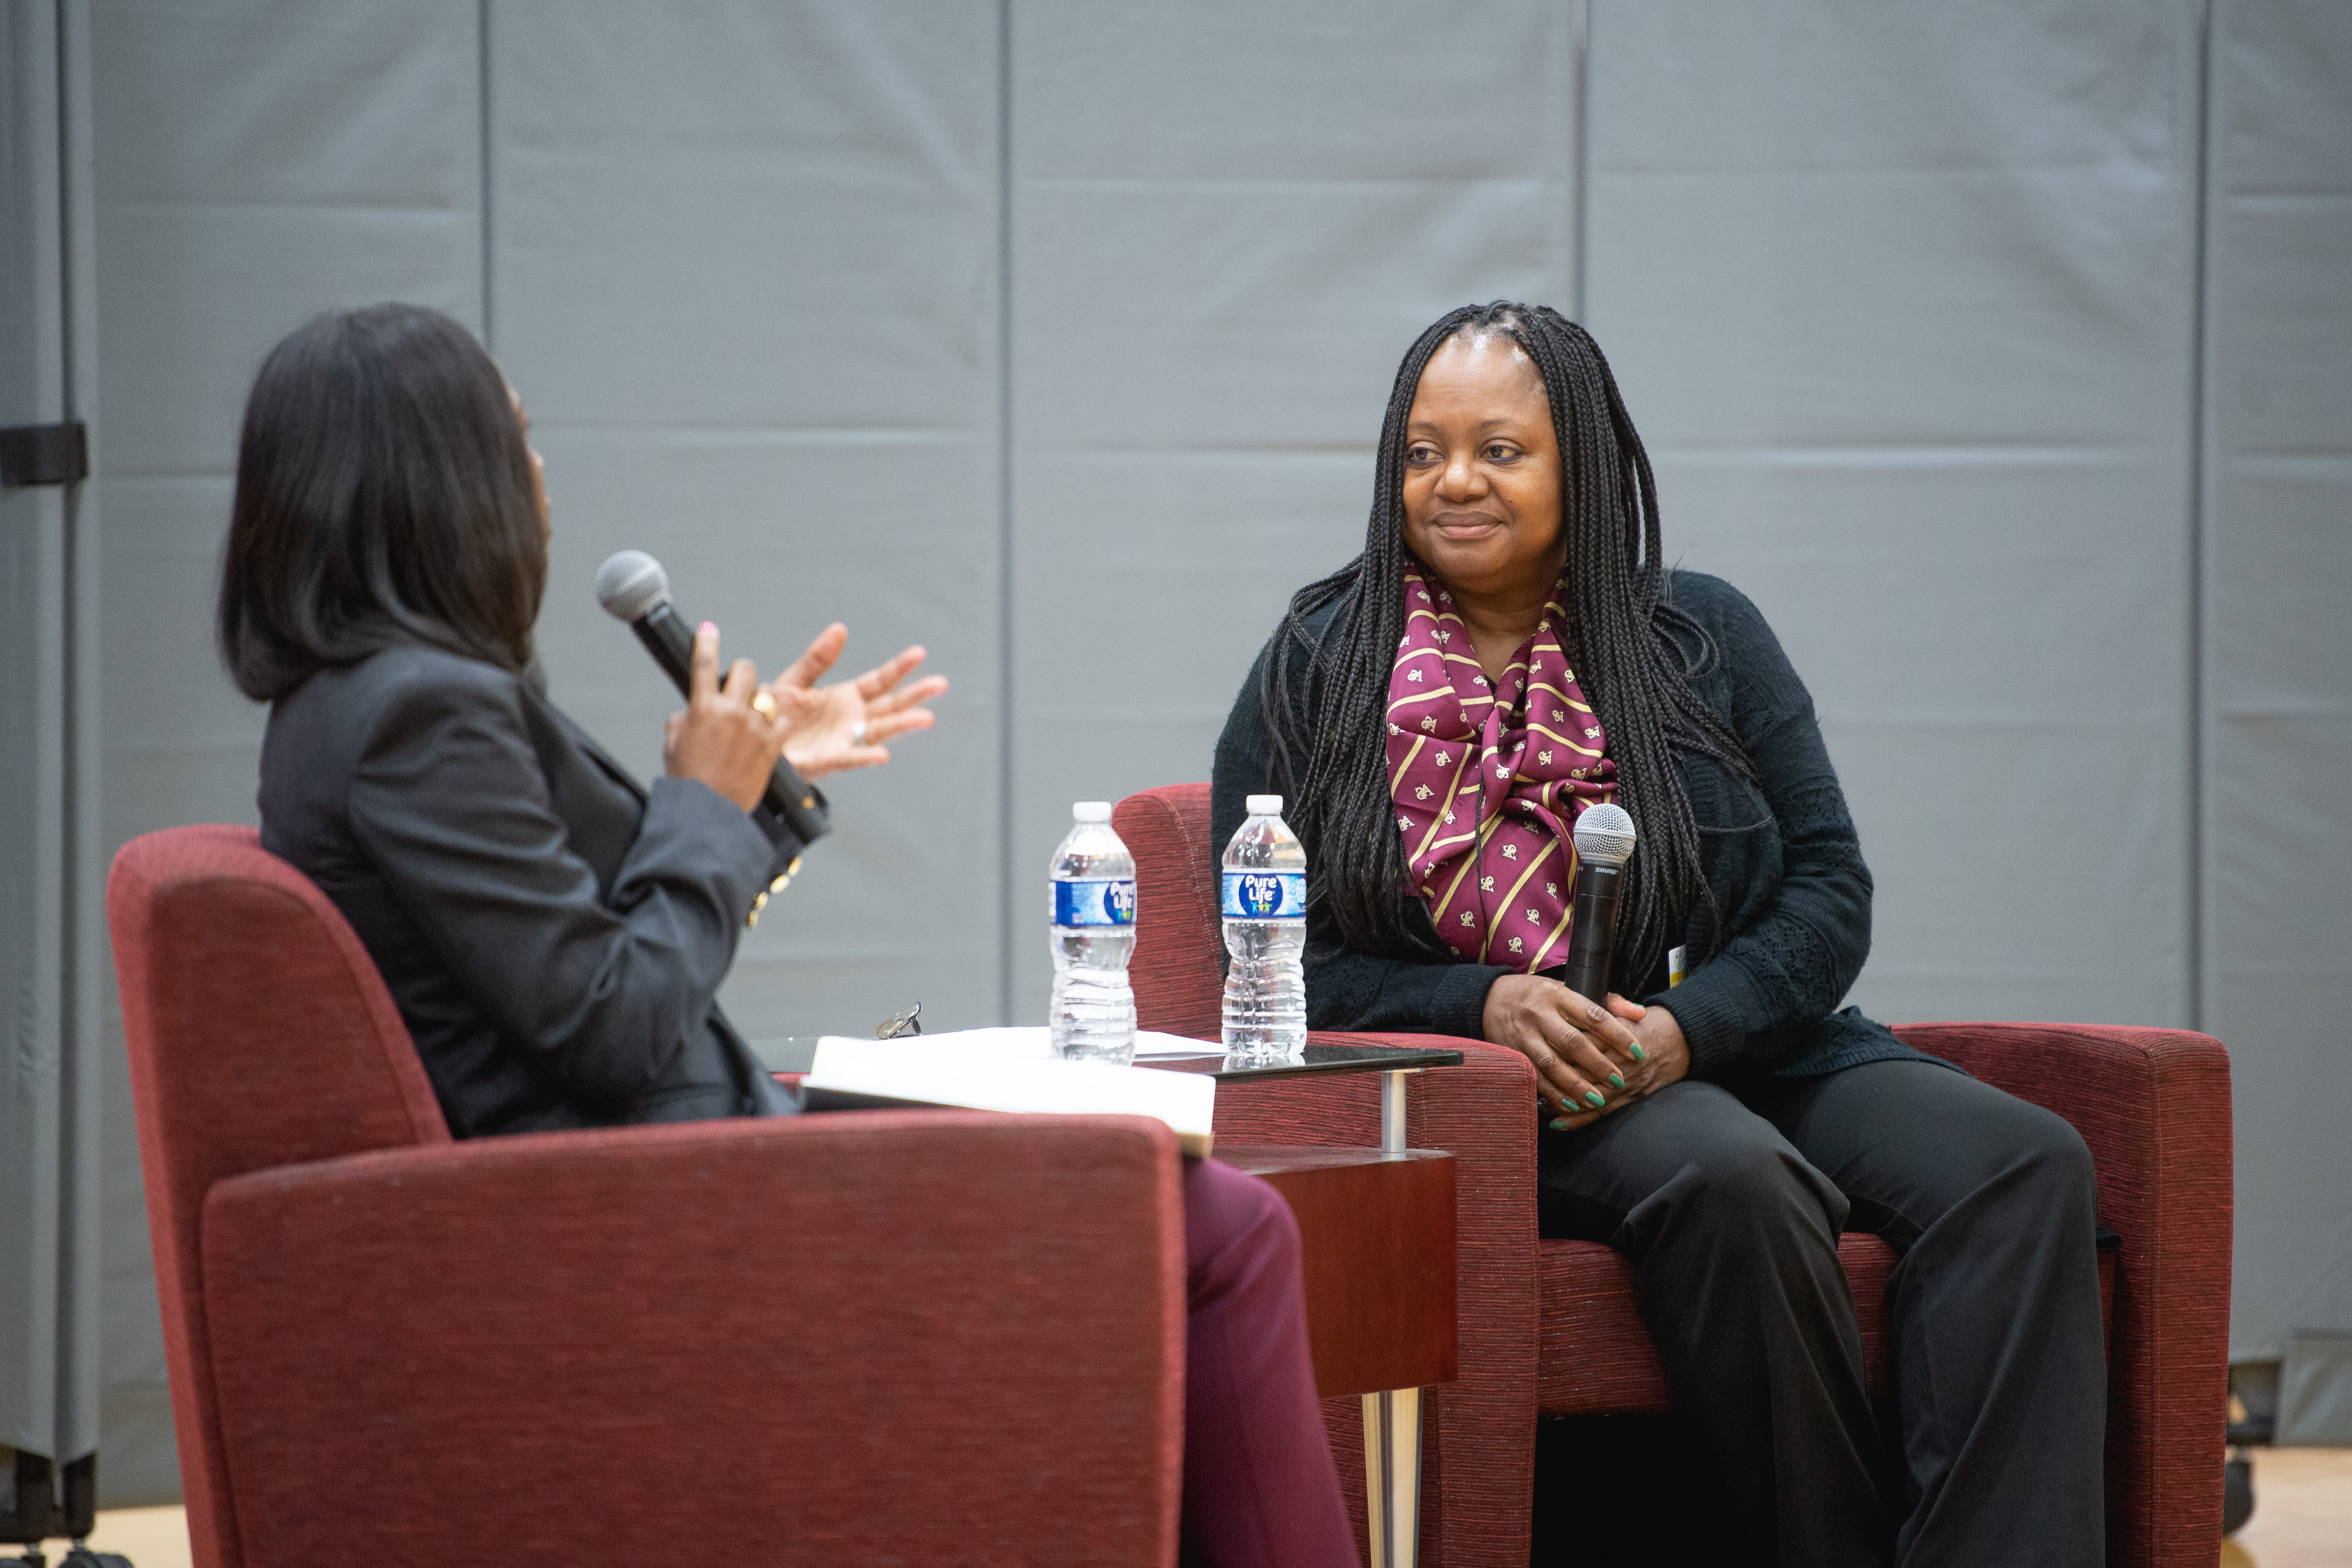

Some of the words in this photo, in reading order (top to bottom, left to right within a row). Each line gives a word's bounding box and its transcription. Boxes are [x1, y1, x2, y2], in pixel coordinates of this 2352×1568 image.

[1245, 875, 1277, 889] Pure
[1113, 895, 1133, 911] Life
[1249, 888, 1273, 904] Life
